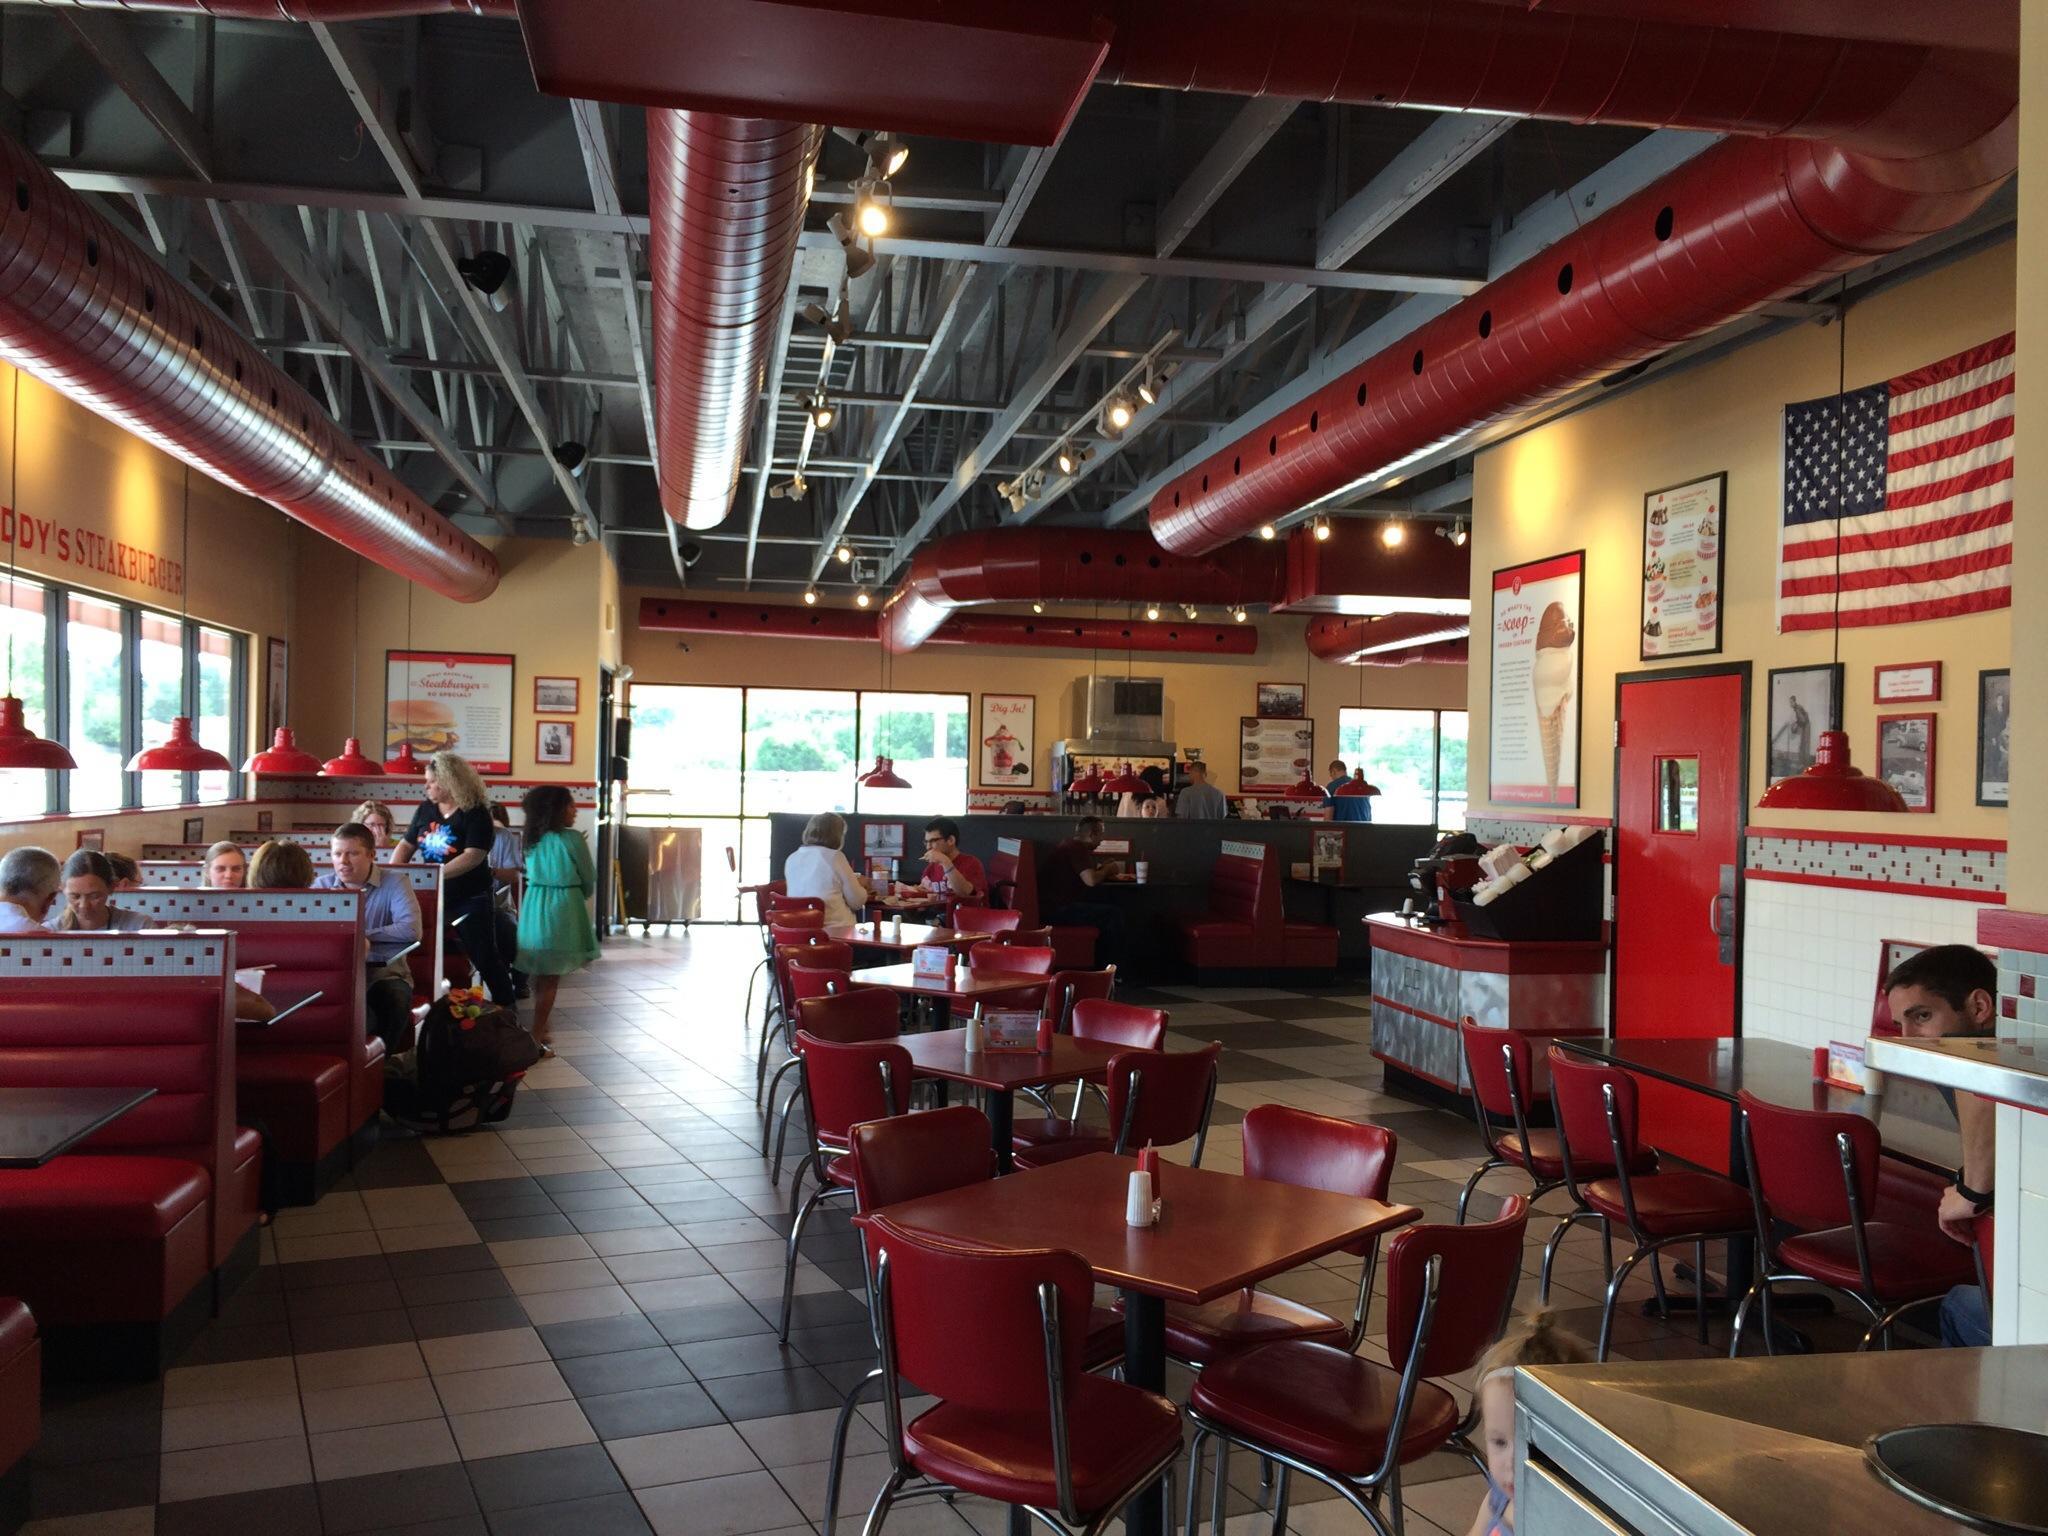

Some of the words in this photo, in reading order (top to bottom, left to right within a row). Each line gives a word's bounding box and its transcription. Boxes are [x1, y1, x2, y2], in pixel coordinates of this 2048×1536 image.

[75, 527, 183, 596] STEAKBURGER
[418, 677, 480, 692] Steakburger
[990, 703, 1008, 715] Dig
